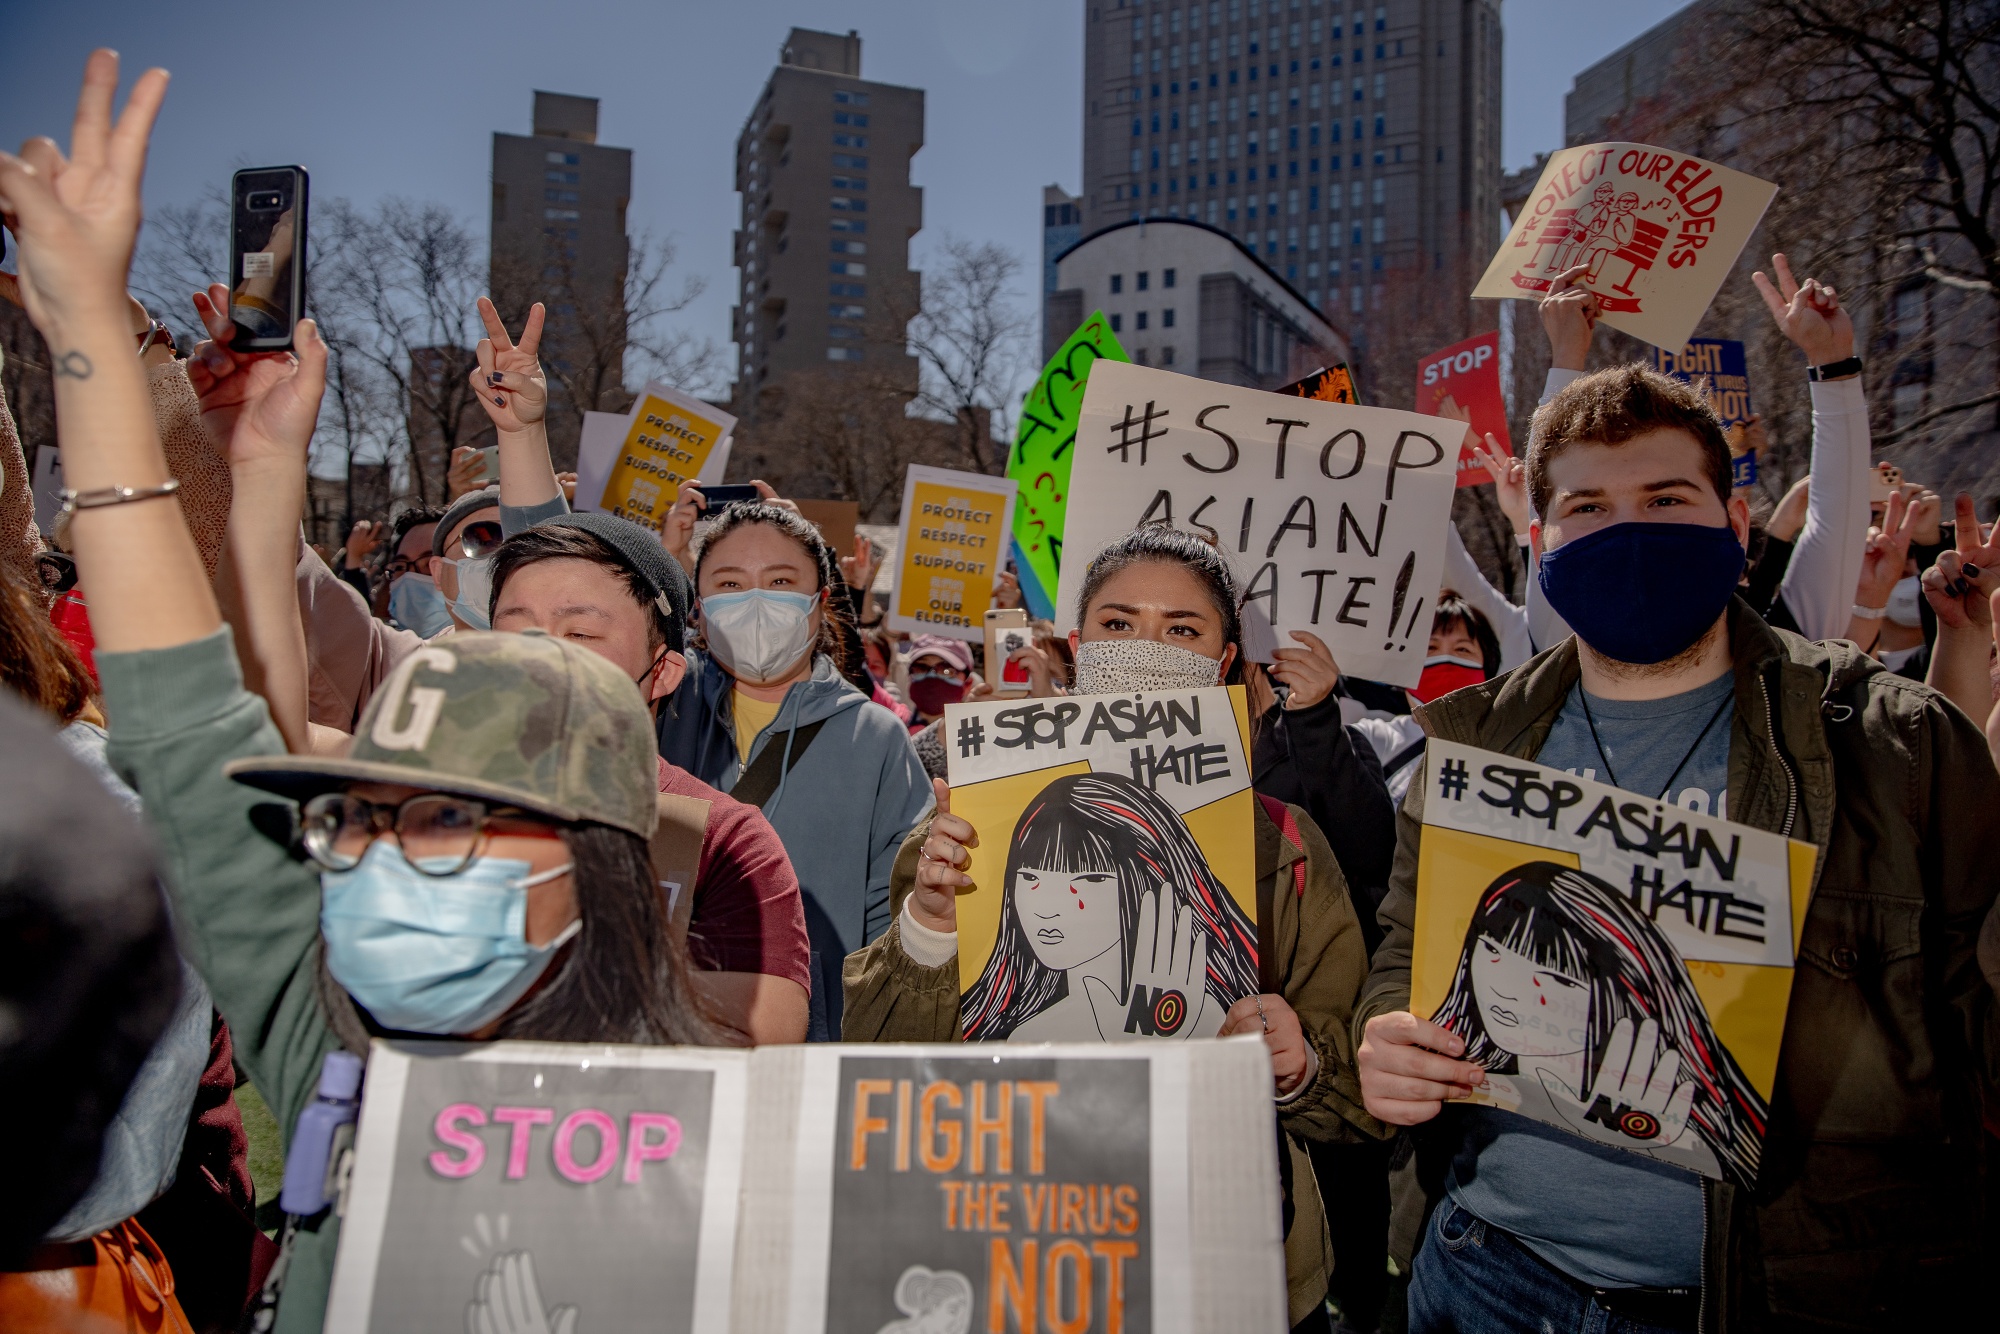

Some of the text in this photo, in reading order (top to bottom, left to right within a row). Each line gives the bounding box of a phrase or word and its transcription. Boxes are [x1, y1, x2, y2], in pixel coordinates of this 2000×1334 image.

[1514, 149, 1723, 270] PROTECT OUR ELDERS
[1520, 278, 1544, 288] STOP
[1423, 345, 1493, 386] STOP
[1657, 343, 1723, 373] FIGHT
[1713, 375, 1747, 390] VIRUS
[637, 433, 694, 464] RESPECT
[645, 413, 706, 446] PROTECT
[1107, 400, 1445, 500] #STOP
[625, 454, 686, 485] SUPPORT
[613, 505, 659, 531] ELDERS
[627, 498, 655, 516] OUR
[922, 502, 992, 524] PROTECT
[1136, 489, 1388, 558] ASIAN
[920, 527, 987, 548] RESPECT
[913, 552, 986, 575] SUPPORT
[915, 609, 971, 628] ELDERS
[929, 598, 963, 612] OUR
[1241, 550, 1424, 652] ATE!!
[371, 646, 458, 752] G
[1130, 742, 1232, 791] HATE
[1630, 864, 1766, 944] HATE
[1124, 983, 1188, 1037] NO
[850, 1078, 1060, 1175] FIGHT
[1584, 1093, 1661, 1140] NO
[428, 1102, 684, 1183] STOP
[940, 1180, 1140, 1235] THE VIRUS
[986, 1237, 1139, 1334] NOT
